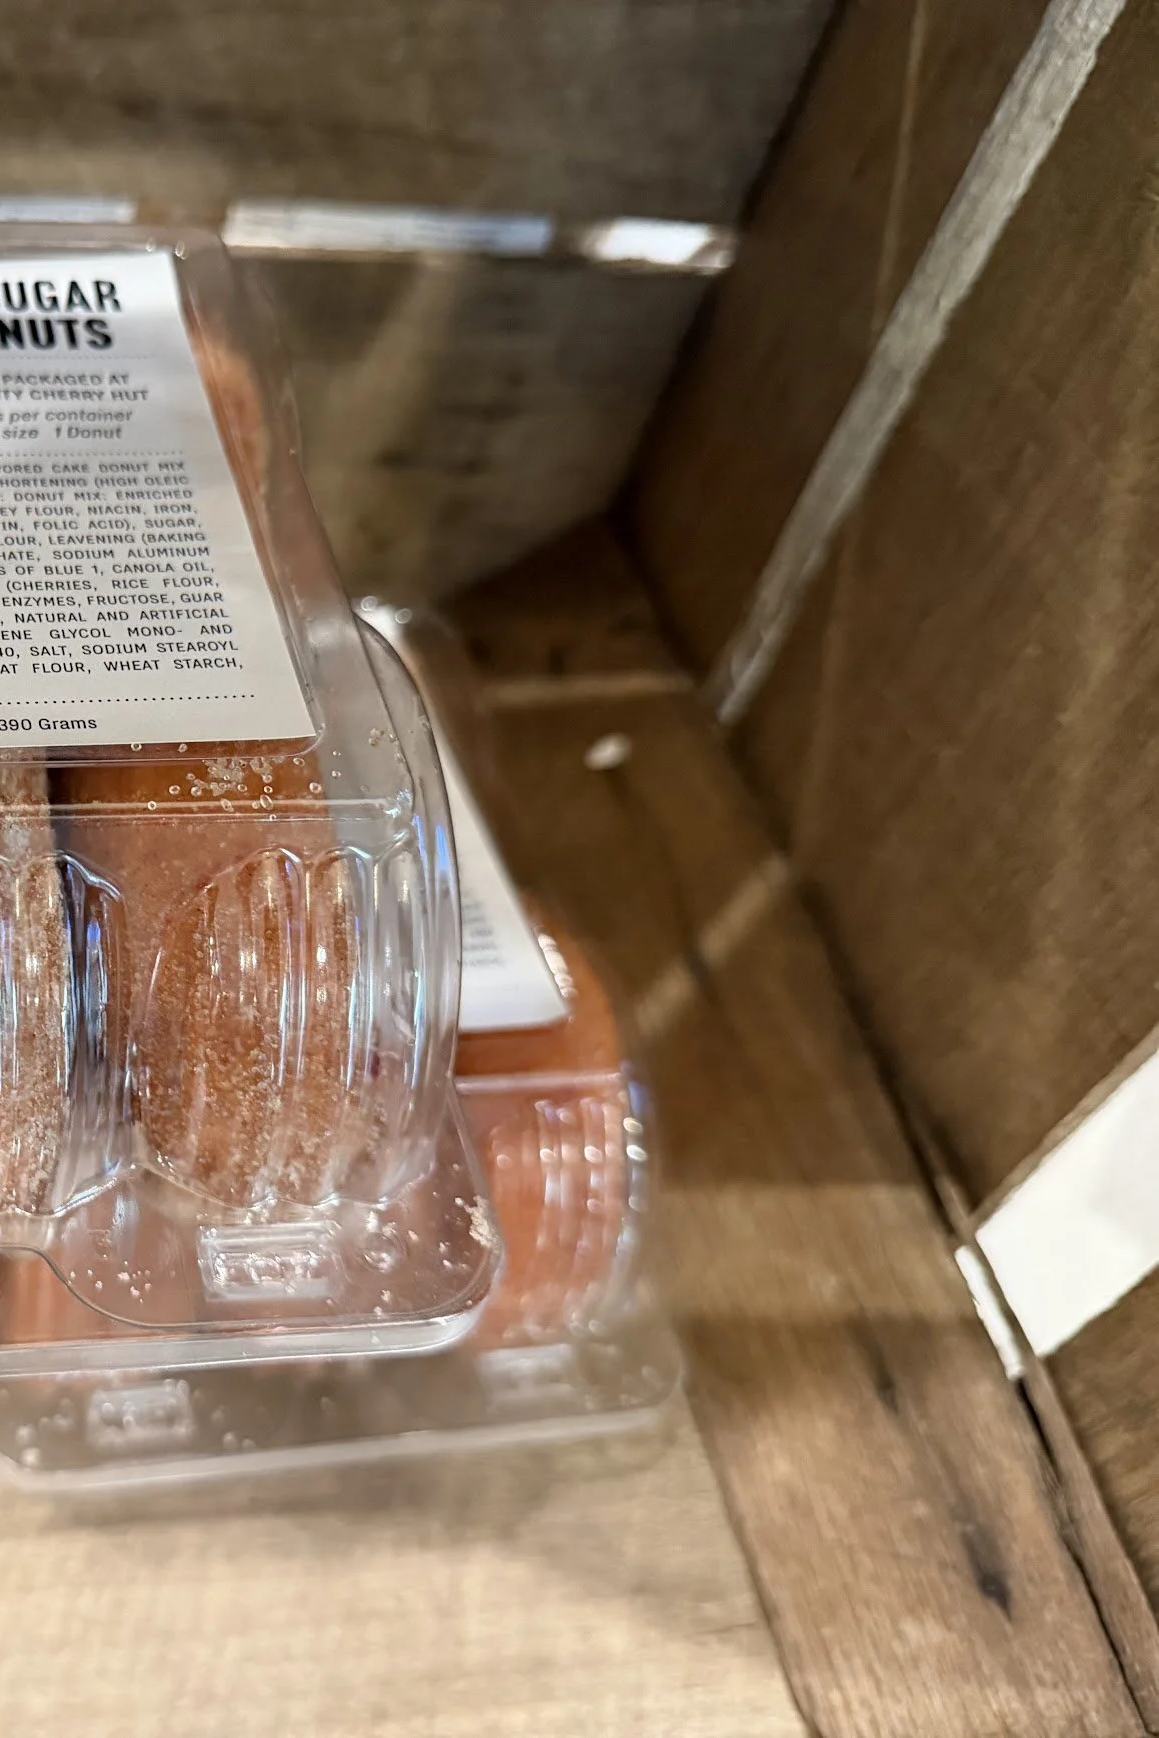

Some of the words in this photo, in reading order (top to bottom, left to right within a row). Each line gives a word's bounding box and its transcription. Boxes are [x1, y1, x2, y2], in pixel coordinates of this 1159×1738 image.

[2, 375, 102, 385] PACKAGED
[109, 375, 129, 385] AT
[29, 390, 104, 401] CHERRY
[111, 390, 149, 401] HUT
[8, 412, 39, 425] per
[45, 409, 132, 422] container
[2, 428, 38, 439] size
[67, 427, 122, 439] Donut
[52, 463, 90, 474] CAKE
[99, 463, 149, 473] DONUT
[159, 461, 185, 471] MIX
[95, 477, 137, 489] (HIGH
[145, 476, 189, 486] OLEIC
[14, 492, 64, 502] DONUT
[116, 490, 193, 500] ENRICHED
[26, 506, 80, 518] FLOUR,
[88, 505, 146, 517] NIACIN,
[154, 504, 197, 515] IRON,
[33, 521, 78, 531] FOLIC
[88, 519, 136, 532] ACID),
[144, 518, 202, 529] SUGAR,
[48, 534, 135, 545] LEAVENING
[141, 532, 206, 545] (BAKING
[53, 550, 114, 560] SODIUM
[128, 547, 210, 558] ALUMINUM
[15, 566, 35, 575] OF
[44, 565, 83, 575] BLUE
[91, 566, 104, 576] 1,
[112, 563, 173, 574] CANOLA
[183, 562, 214, 574] OIL,
[6, 580, 98, 593] (CHERRIES,
[112, 579, 148, 589] RICE
[164, 577, 219, 589] FLOUR,
[2, 595, 82, 609] ENZYMES,
[87, 594, 175, 606] FRUCTOSE,
[181, 592, 223, 603] GUAR
[15, 611, 87, 624] NATURAL
[97, 610, 129, 621] AND
[140, 608, 229, 620] ARTIFICIAL
[50, 627, 111, 639] GLYCOL
[127, 626, 183, 637] MONO-
[200, 624, 233, 635] AND
[30, 646, 73, 657] SALT,
[82, 643, 147, 655] SODIUM
[157, 640, 239, 653] STEAROYL
[33, 662, 91, 674] FLOUR,
[104, 659, 160, 671] WHEAT
[174, 658, 243, 670] STARCH,
[38, 717, 97, 730] Grams
